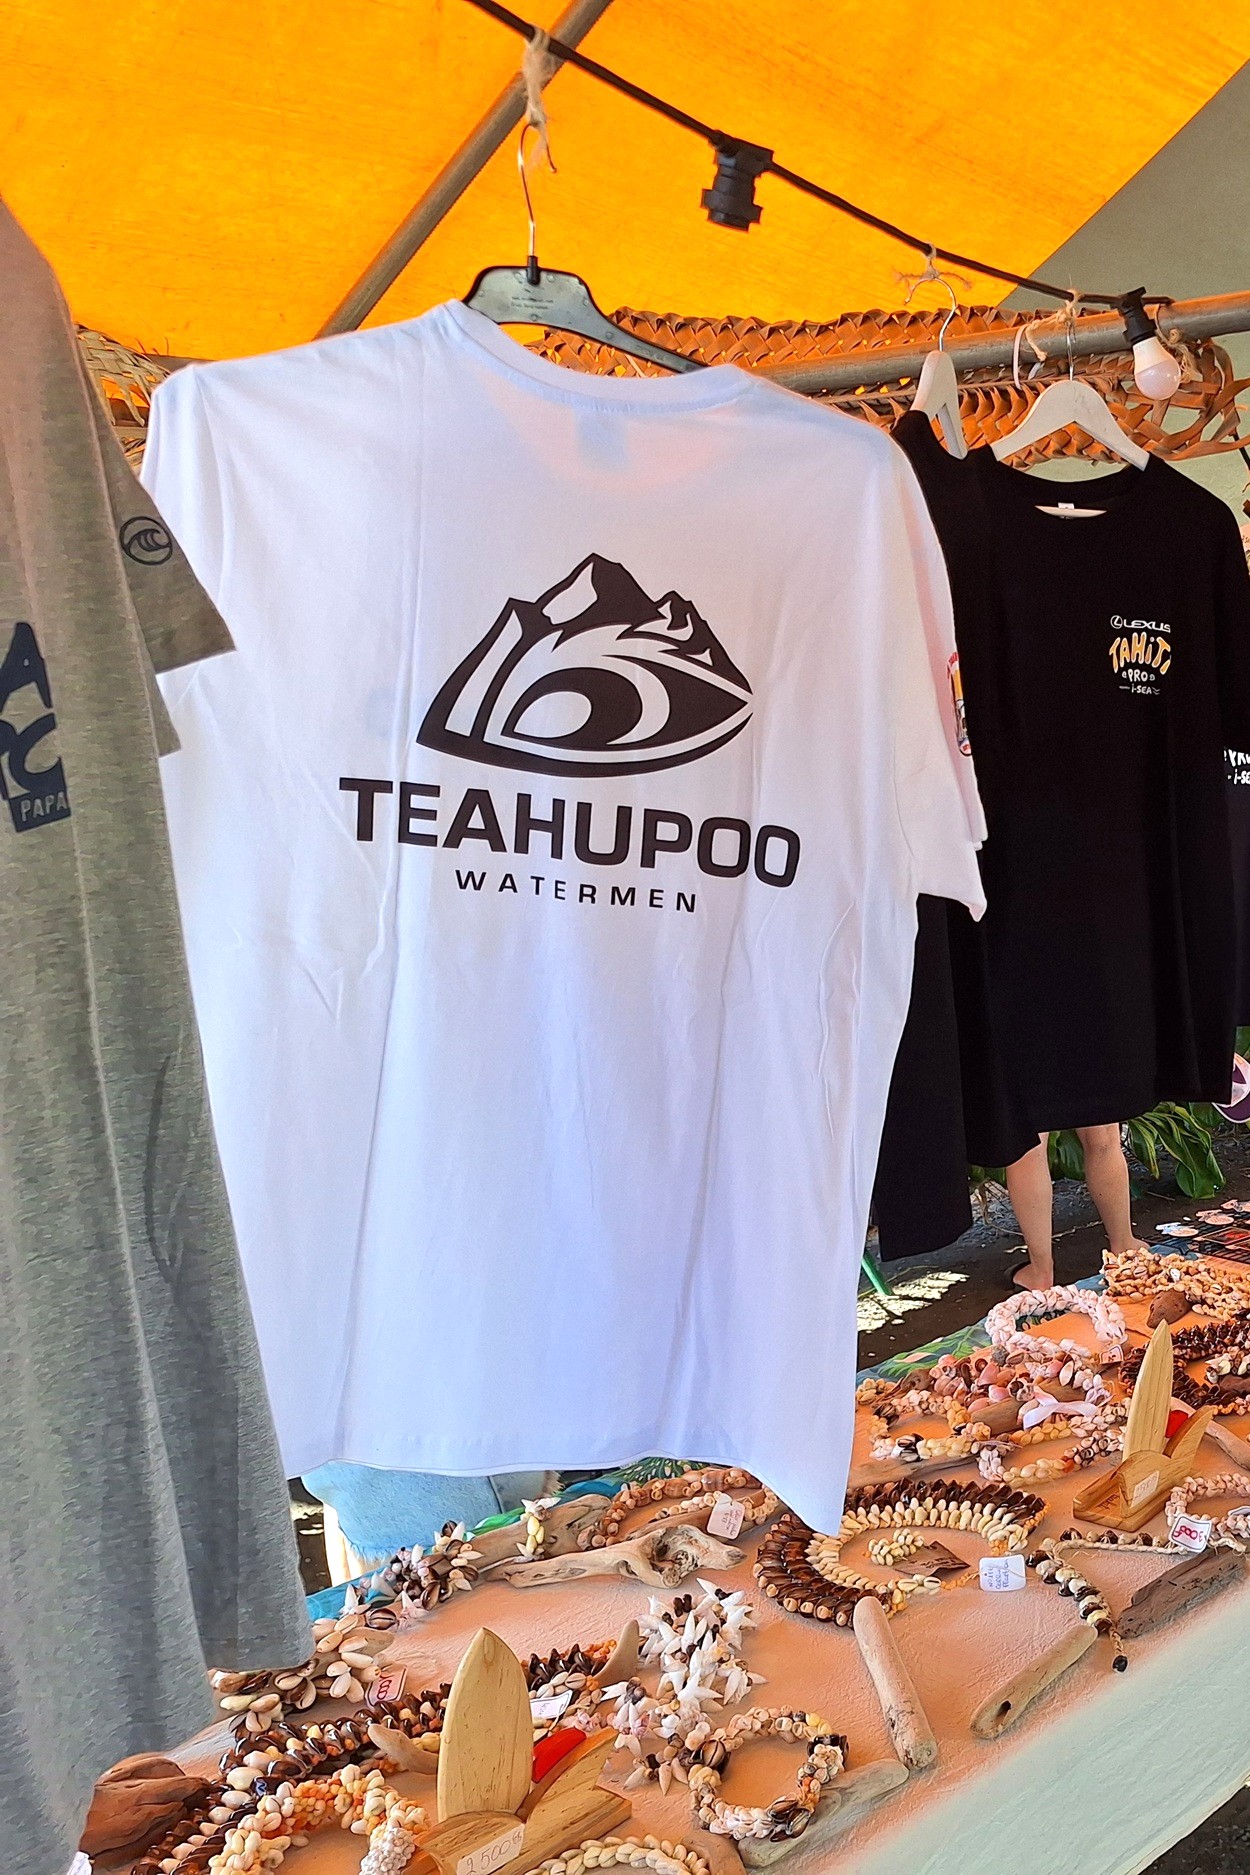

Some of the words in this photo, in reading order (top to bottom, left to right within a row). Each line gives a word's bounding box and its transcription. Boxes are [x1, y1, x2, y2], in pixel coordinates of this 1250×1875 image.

[1123, 618, 1171, 633] LEXUS
[1127, 668, 1149, 682] PRO
[339, 776, 801, 888] TEAHUPOO
[454, 869, 697, 913] WATERMEN
